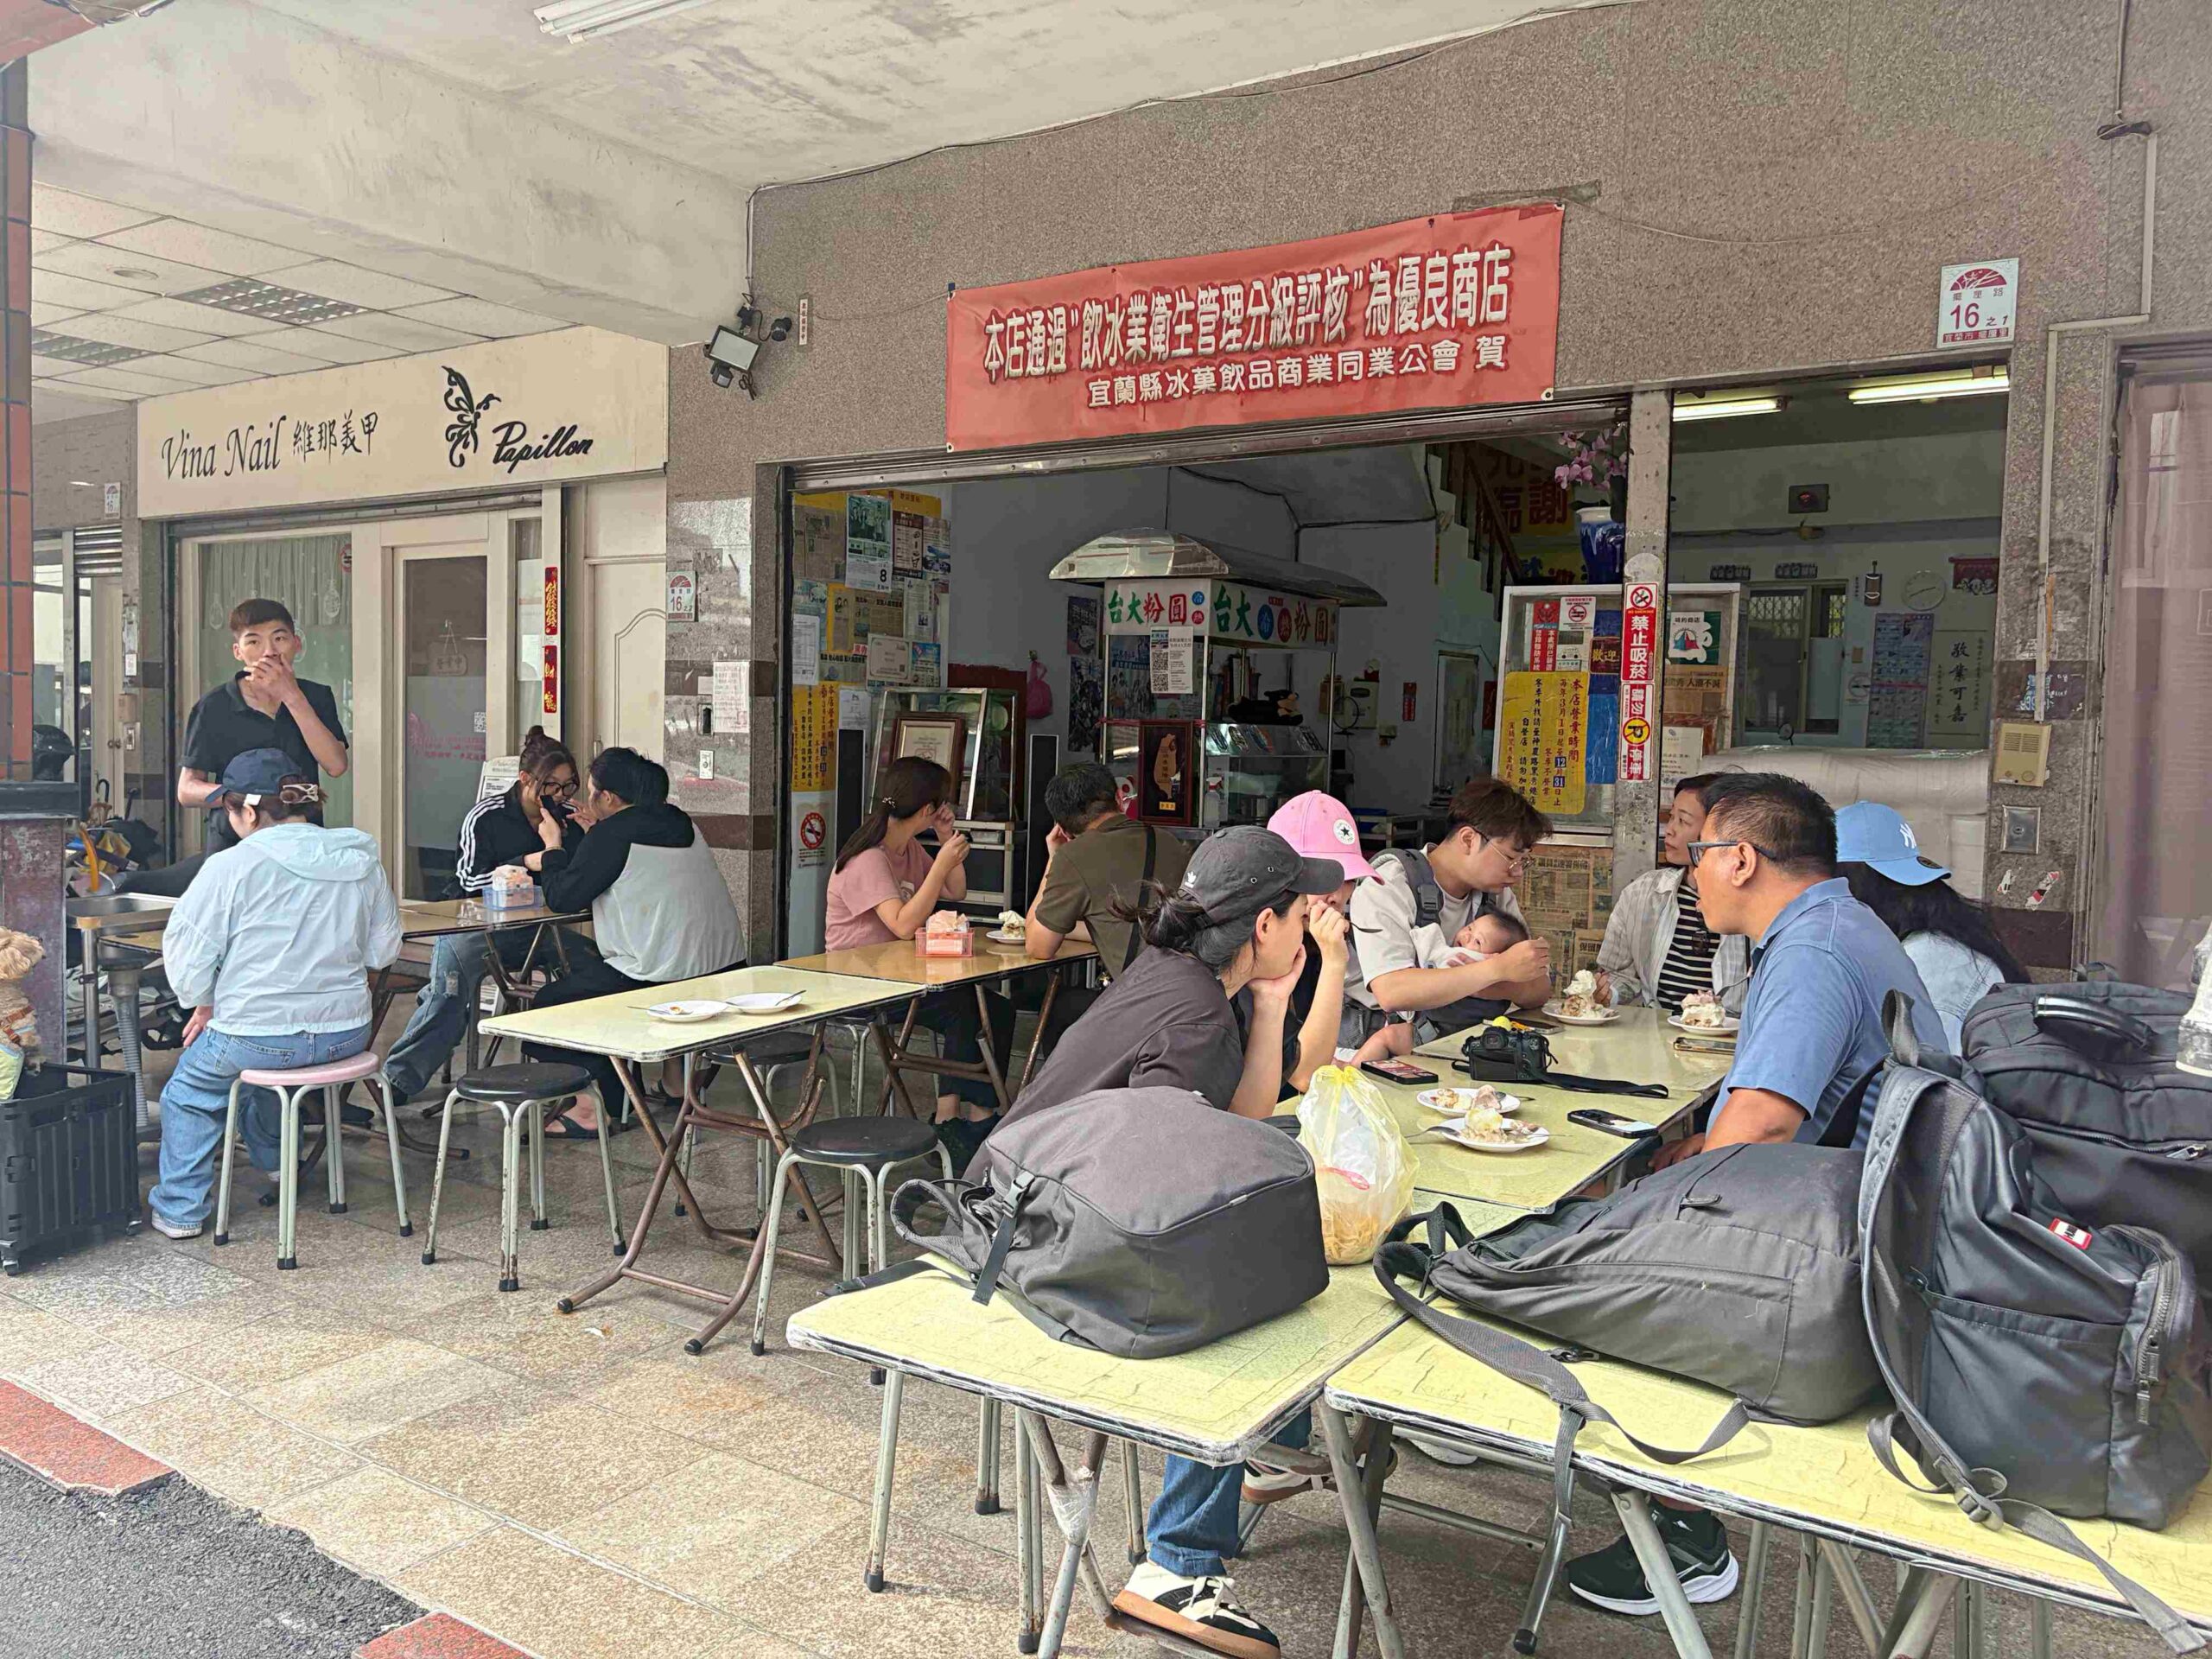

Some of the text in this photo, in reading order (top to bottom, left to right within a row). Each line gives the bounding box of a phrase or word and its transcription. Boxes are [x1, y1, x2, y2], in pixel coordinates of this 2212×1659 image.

[1950, 303, 1980, 329] 16
[1088, 335, 1506, 408] 宜蘭縣冰菓飲品商業同業公會 賀
[162, 415, 287, 480] Vina Nail
[293, 410, 378, 463] 維那美甲
[492, 421, 594, 474] Papillon
[880, 569, 887, 582] 8
[671, 595, 682, 612] 16
[1108, 589, 1187, 625] 台大粉圓
[1214, 584, 1254, 637] 台大
[1592, 648, 1619, 663] 歡迎
[1629, 615, 1649, 679] 禁止吸菸
[1630, 688, 1645, 715] 請勿
[1630, 748, 1643, 774] 停車
